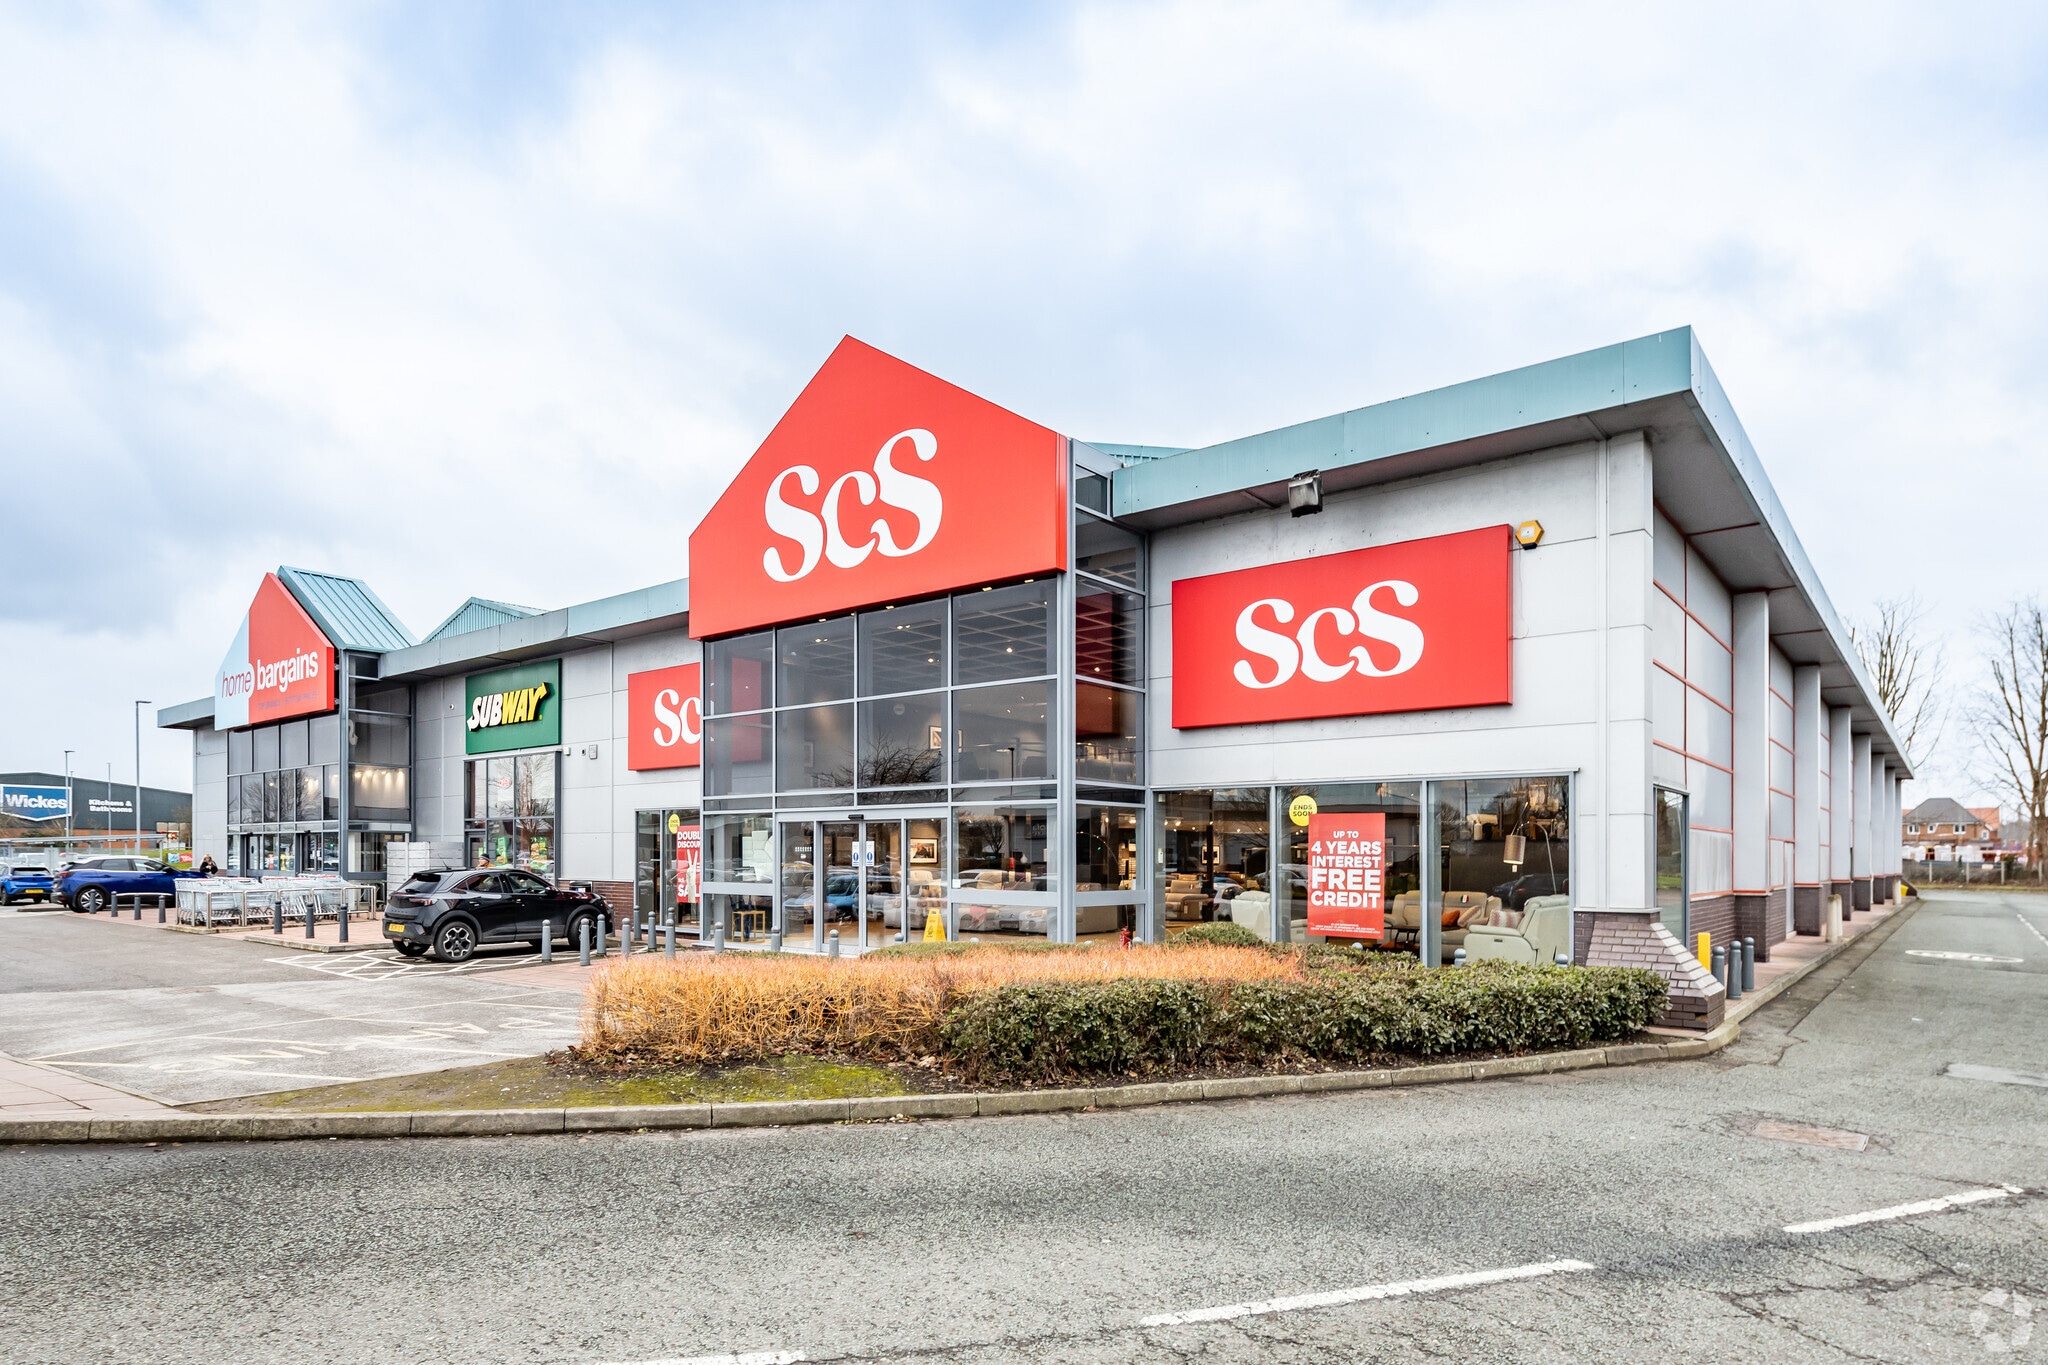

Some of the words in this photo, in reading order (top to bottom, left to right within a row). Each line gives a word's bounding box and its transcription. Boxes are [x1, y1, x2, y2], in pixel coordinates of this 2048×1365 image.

[221, 671, 252, 699] home
[257, 648, 319, 693] bargains
[466, 681, 550, 732] SUBWAY
[653, 689, 701, 747] Sc
[5, 794, 67, 809] Wickes
[677, 831, 701, 840] DOUBL
[1333, 831, 1345, 839] UP
[1346, 831, 1359, 839] TO
[677, 840, 701, 848] DISCOUN
[1310, 840, 1322, 854] 4
[1325, 841, 1382, 855] YEARS
[1312, 855, 1381, 868] INTEREST
[1311, 868, 1381, 891] FREE
[677, 884, 701, 897] SAL
[1310, 890, 1381, 908] CREDIT
